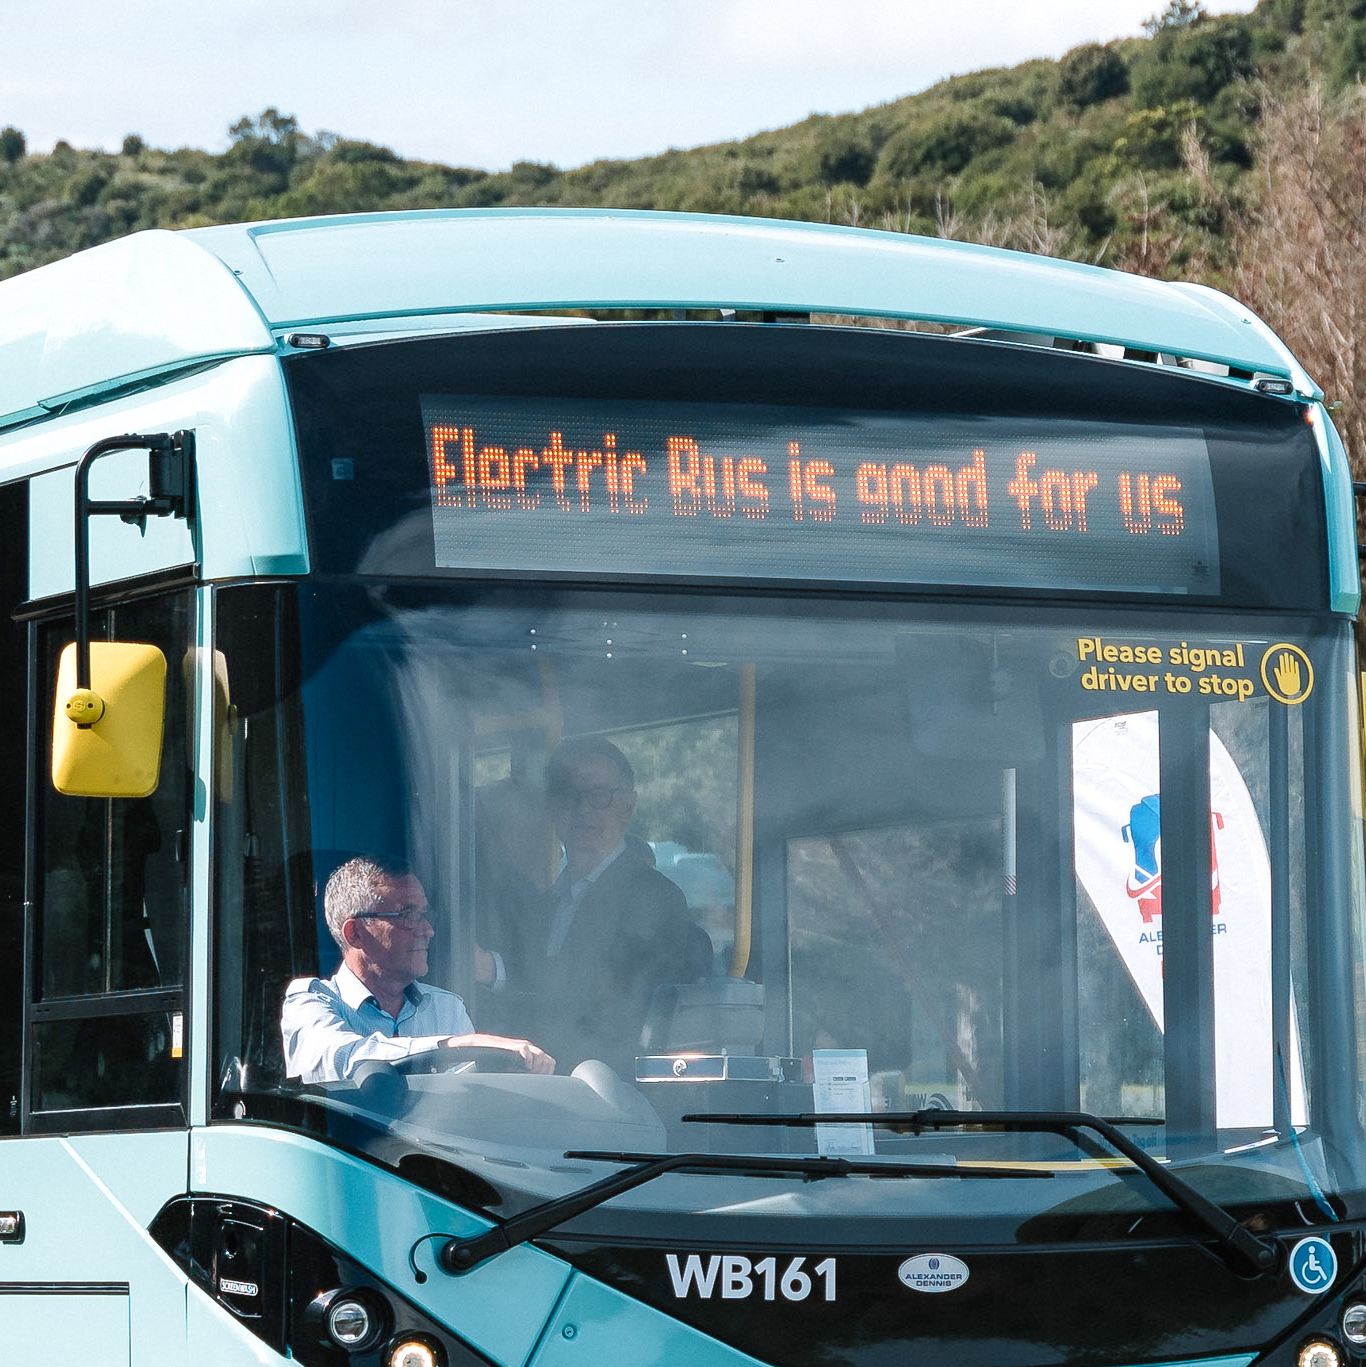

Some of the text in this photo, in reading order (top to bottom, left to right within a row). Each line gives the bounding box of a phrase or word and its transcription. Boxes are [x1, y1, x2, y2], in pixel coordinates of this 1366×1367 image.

[669, 436, 770, 519] Bus
[788, 441, 837, 522] is
[857, 450, 988, 528] good
[1009, 452, 1098, 532] for
[1120, 473, 1185, 535] us
[1077, 637, 1245, 672] Please signal
[1081, 666, 1255, 702] driver to stop
[665, 1253, 836, 1302] WB161
